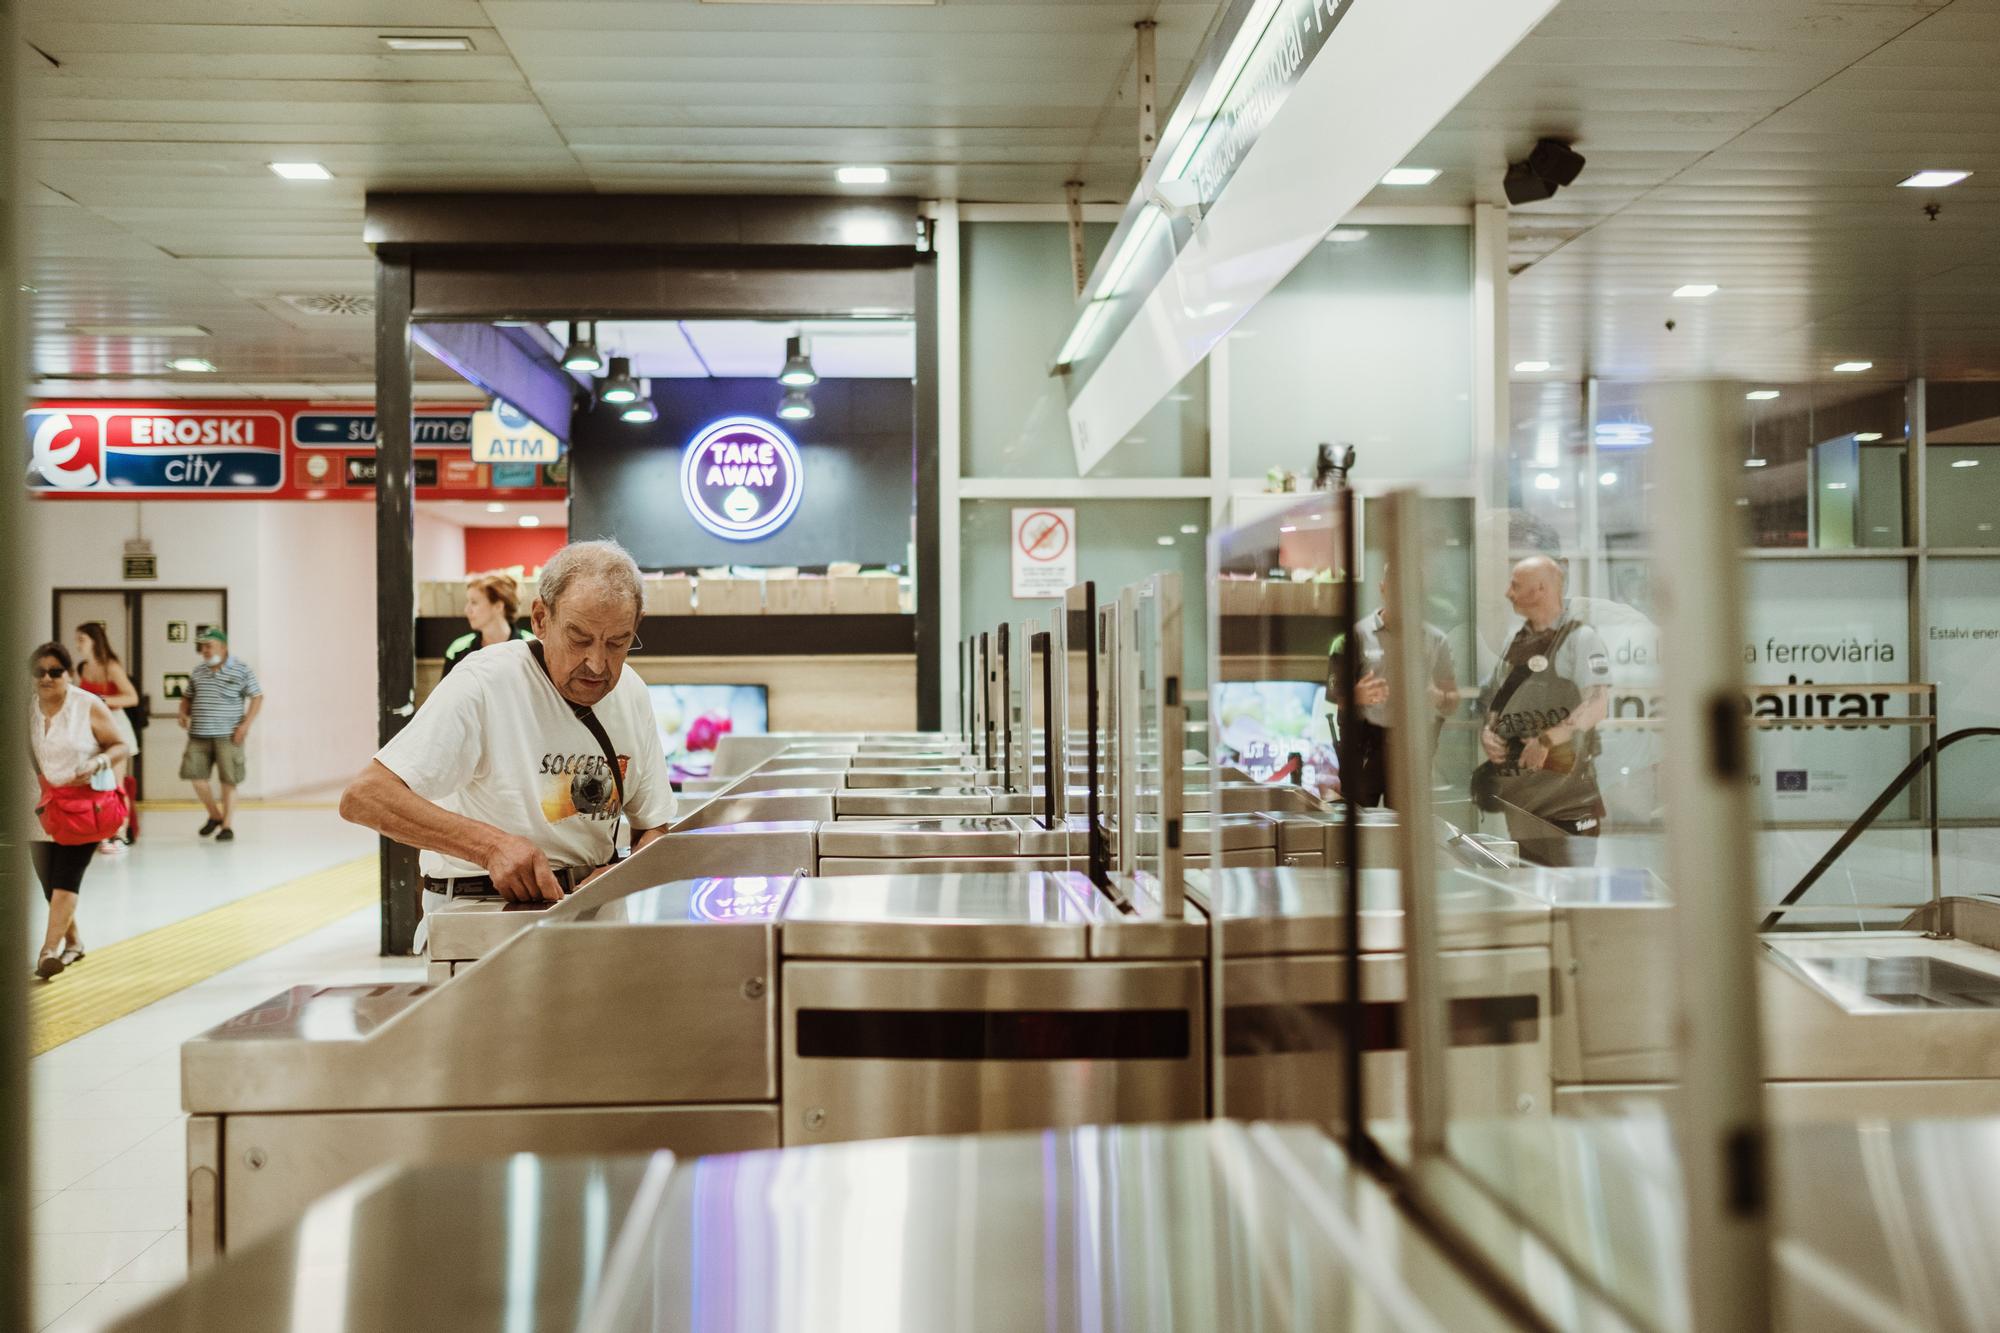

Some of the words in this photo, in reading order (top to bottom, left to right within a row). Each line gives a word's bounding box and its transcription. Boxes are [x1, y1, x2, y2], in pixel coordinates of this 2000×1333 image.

[1232, 6, 1304, 149] Intermodal
[130, 418, 255, 445] EROSKI
[488, 438, 543, 456] ATM
[709, 442, 775, 464] TAKE
[164, 454, 221, 487] city
[705, 464, 778, 487] AWAY
[1929, 626, 1969, 640] Estalvi
[1972, 629, 2000, 640] ener
[1615, 639, 1647, 665] de
[1766, 637, 1895, 664] ferroviària
[539, 753, 606, 776] SOCCER
